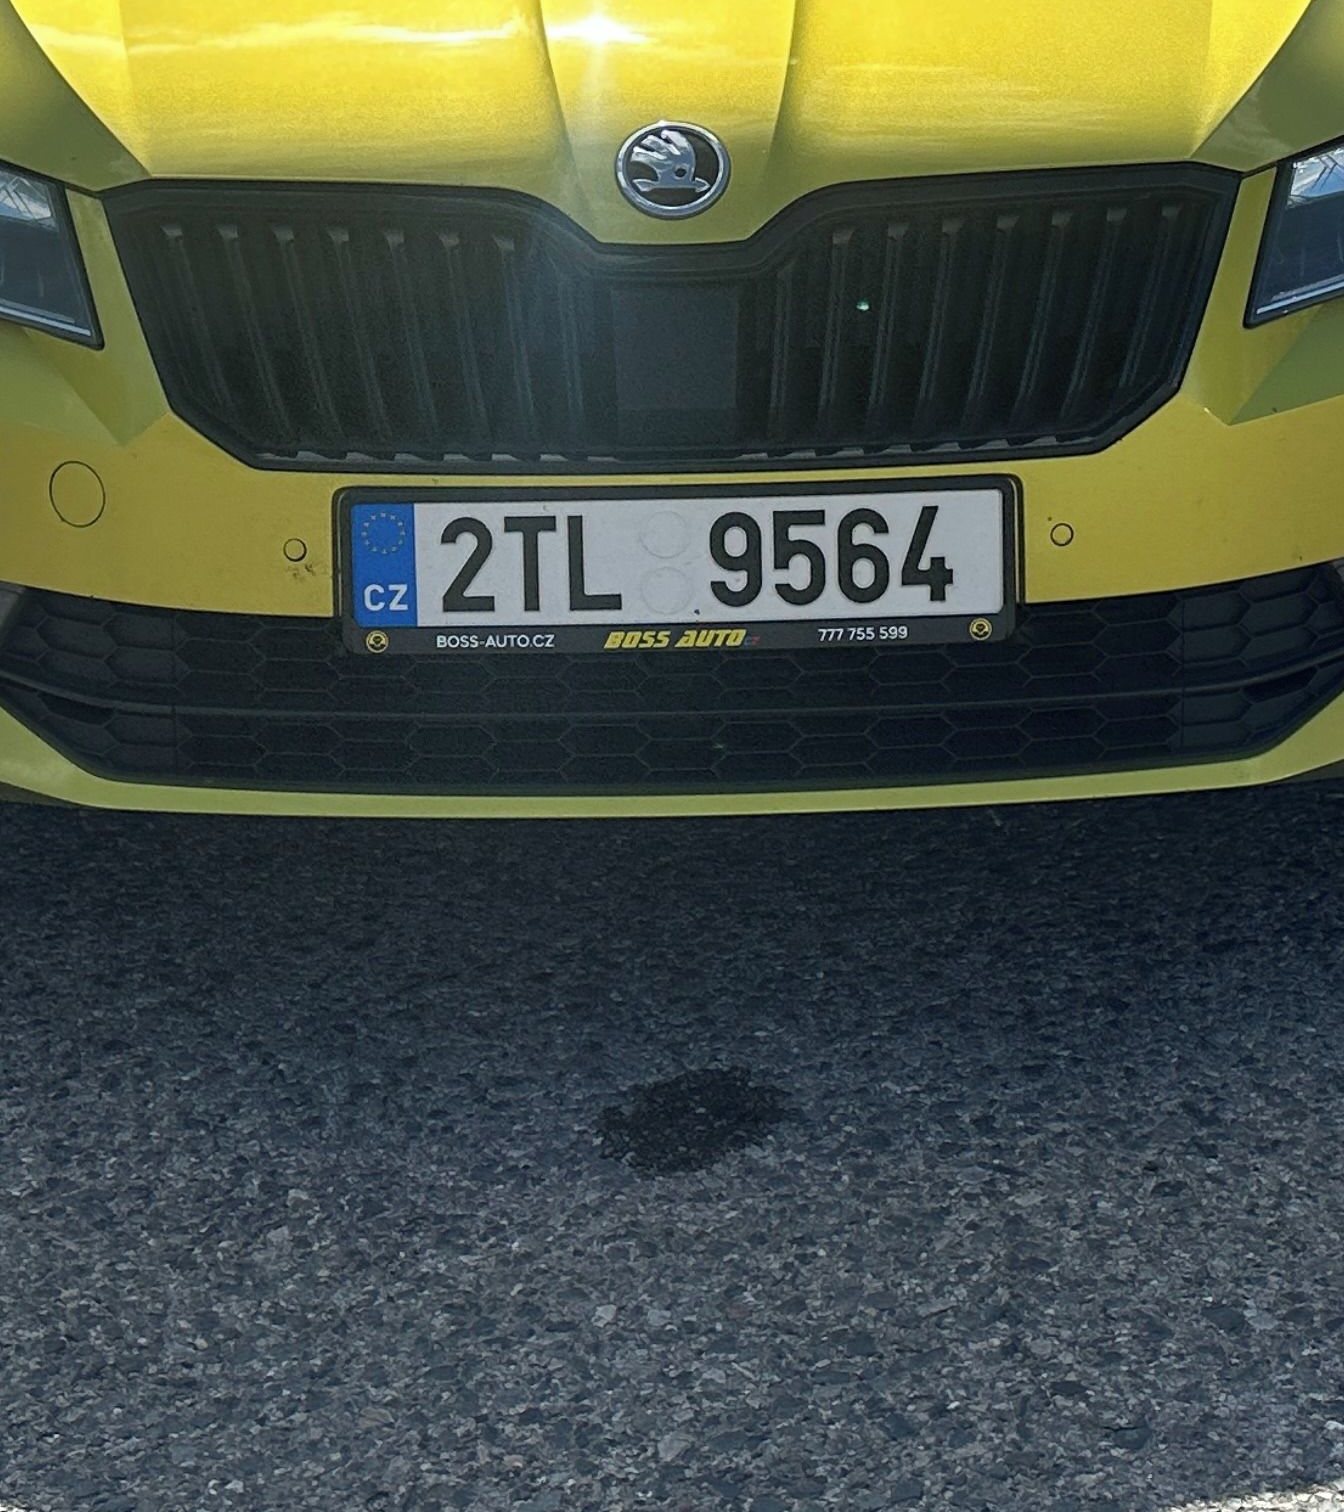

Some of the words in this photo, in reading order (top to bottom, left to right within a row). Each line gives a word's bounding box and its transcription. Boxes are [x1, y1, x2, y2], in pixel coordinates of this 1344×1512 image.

[441, 514, 622, 613] 2TL
[708, 504, 954, 609] 9564
[364, 585, 408, 612] CZ
[436, 633, 555, 650] BOSS-AUTO.CZ
[603, 630, 671, 650] BOSS
[674, 628, 747, 648] AUTO
[817, 627, 844, 642] 777
[846, 626, 876, 641] 755
[878, 625, 909, 640] 599
